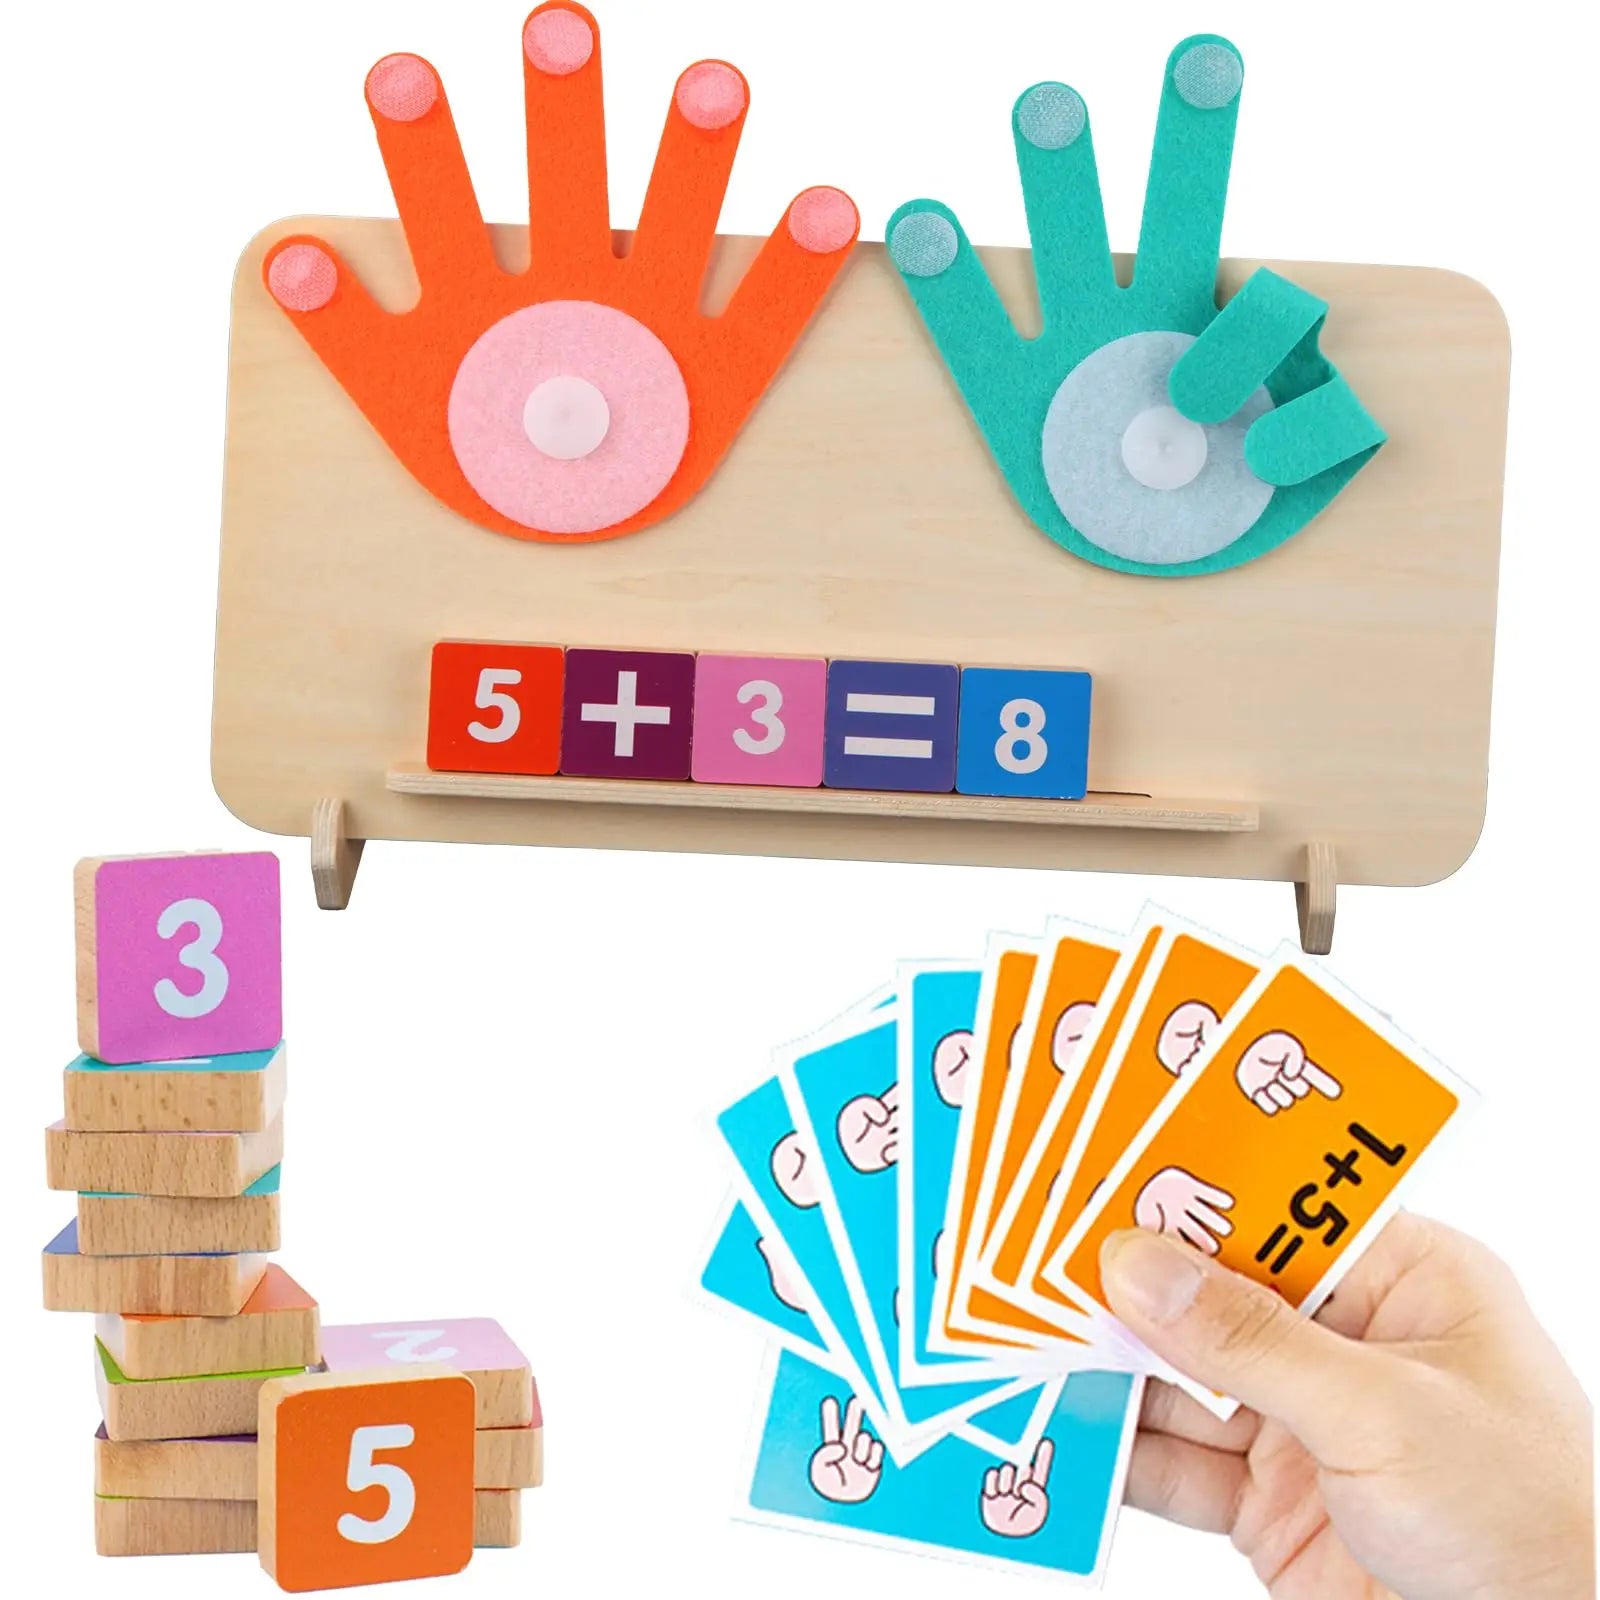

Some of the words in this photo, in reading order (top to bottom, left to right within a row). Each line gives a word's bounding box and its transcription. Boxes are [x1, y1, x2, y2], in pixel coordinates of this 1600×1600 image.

[467, 668, 521, 743] 5
[732, 679, 786, 755] 3
[994, 698, 1049, 774] 8
[154, 898, 230, 1019] 3
[371, 1329, 459, 1363] 2
[337, 1423, 416, 1544] 5
